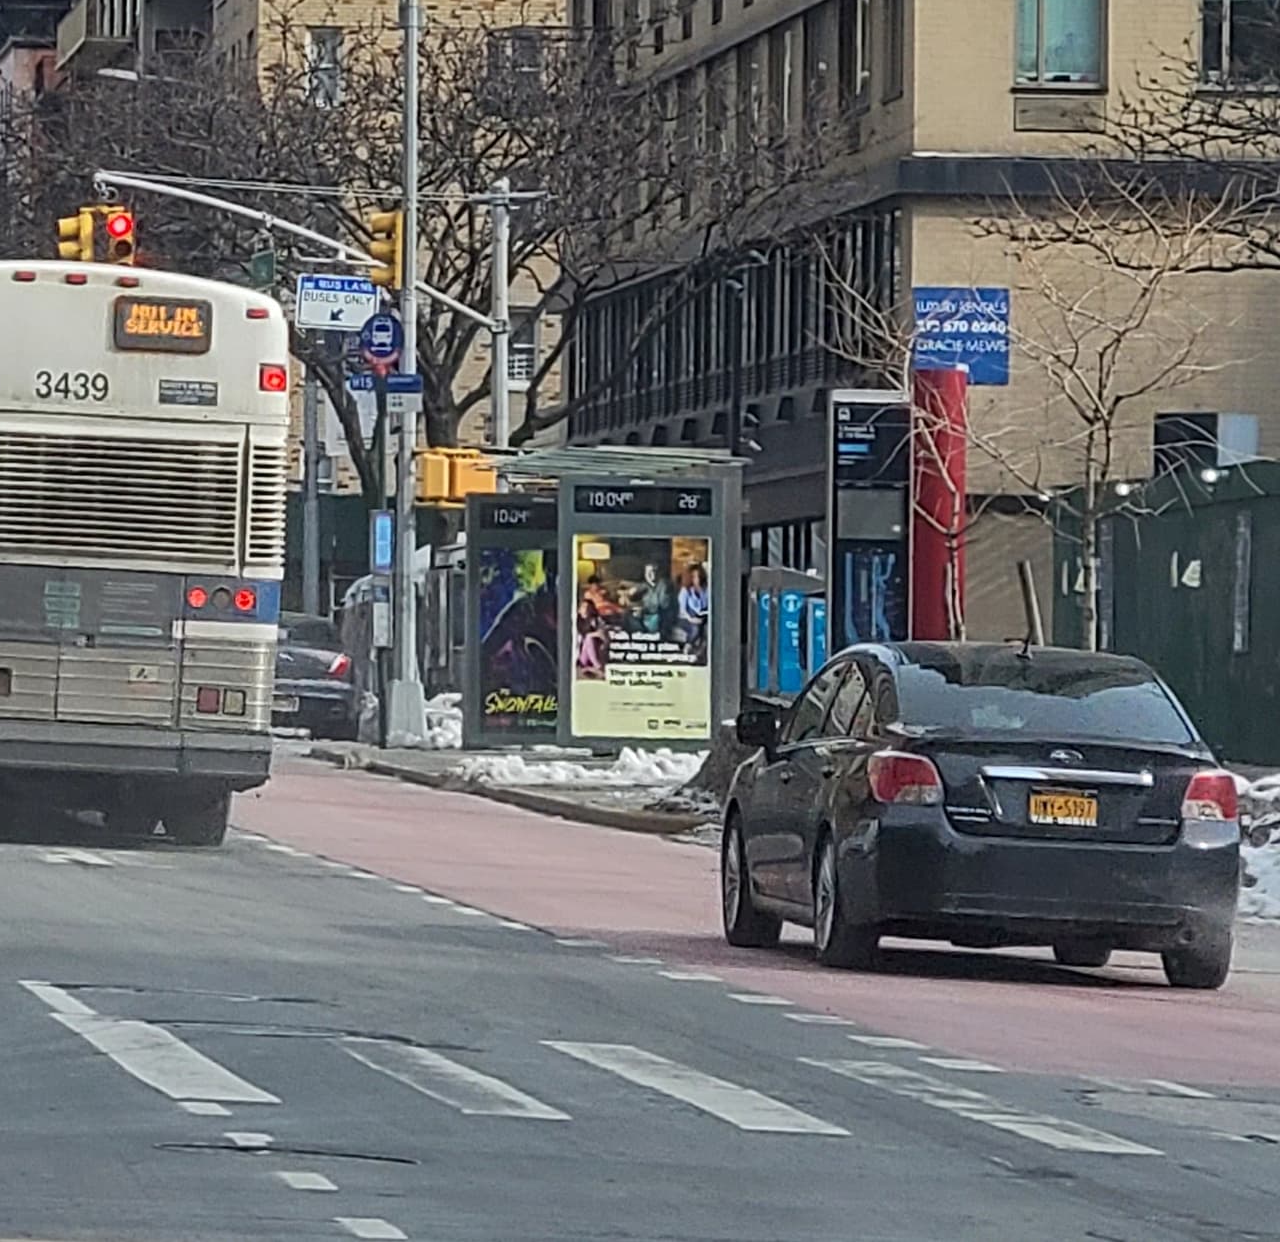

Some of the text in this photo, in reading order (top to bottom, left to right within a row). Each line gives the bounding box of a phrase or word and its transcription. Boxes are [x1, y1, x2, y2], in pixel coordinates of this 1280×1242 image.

[318, 279, 342, 290] BUS
[303, 291, 373, 306] BUSES ONLY
[175, 306, 198, 322] IN
[124, 318, 204, 337] SERVICE
[966, 339, 1007, 353] MEWS
[35, 370, 110, 402] 3439
